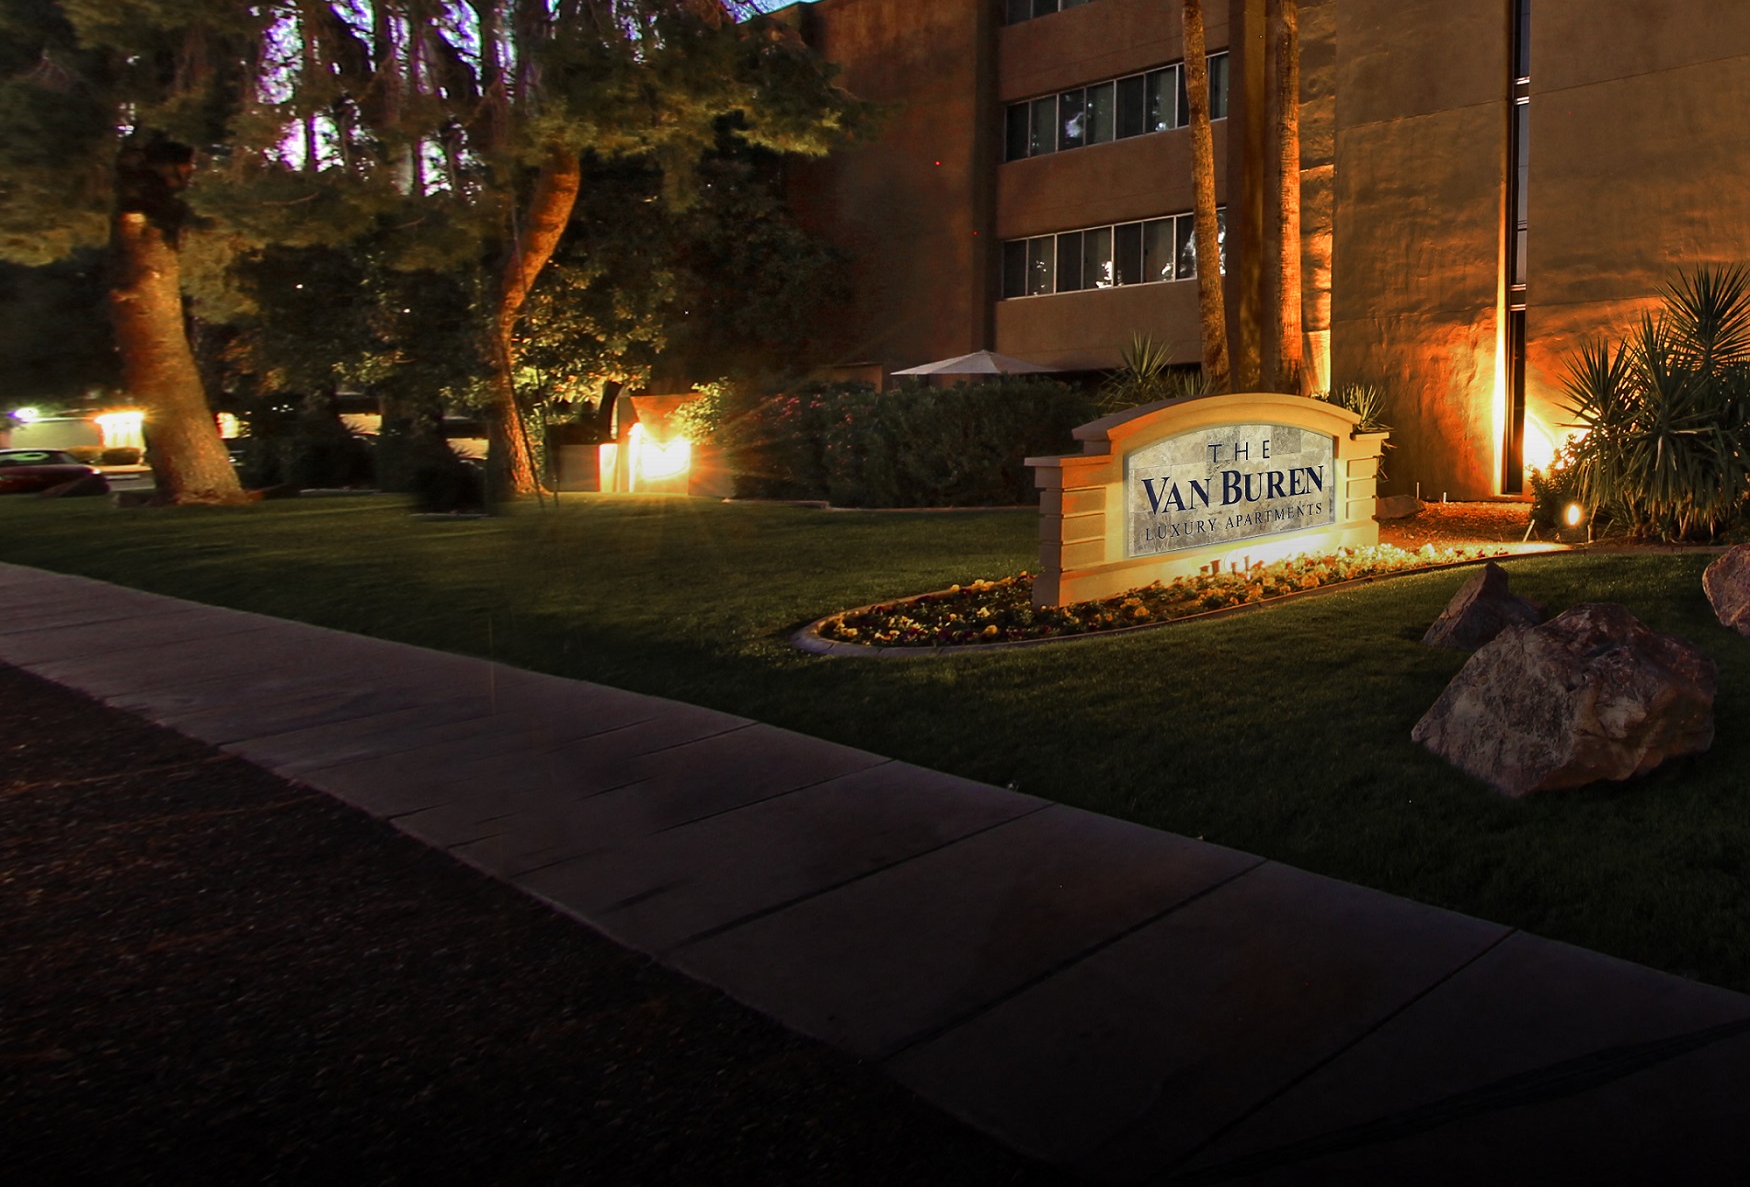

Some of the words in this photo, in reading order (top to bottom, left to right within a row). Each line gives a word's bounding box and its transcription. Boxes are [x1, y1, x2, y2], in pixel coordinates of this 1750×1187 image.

[1208, 439, 1271, 463] THE
[1141, 476, 1212, 515] VAN
[1221, 465, 1325, 507] BUREN
[1145, 518, 1217, 542] LUXURY
[1225, 501, 1324, 530] APARTMENTS
